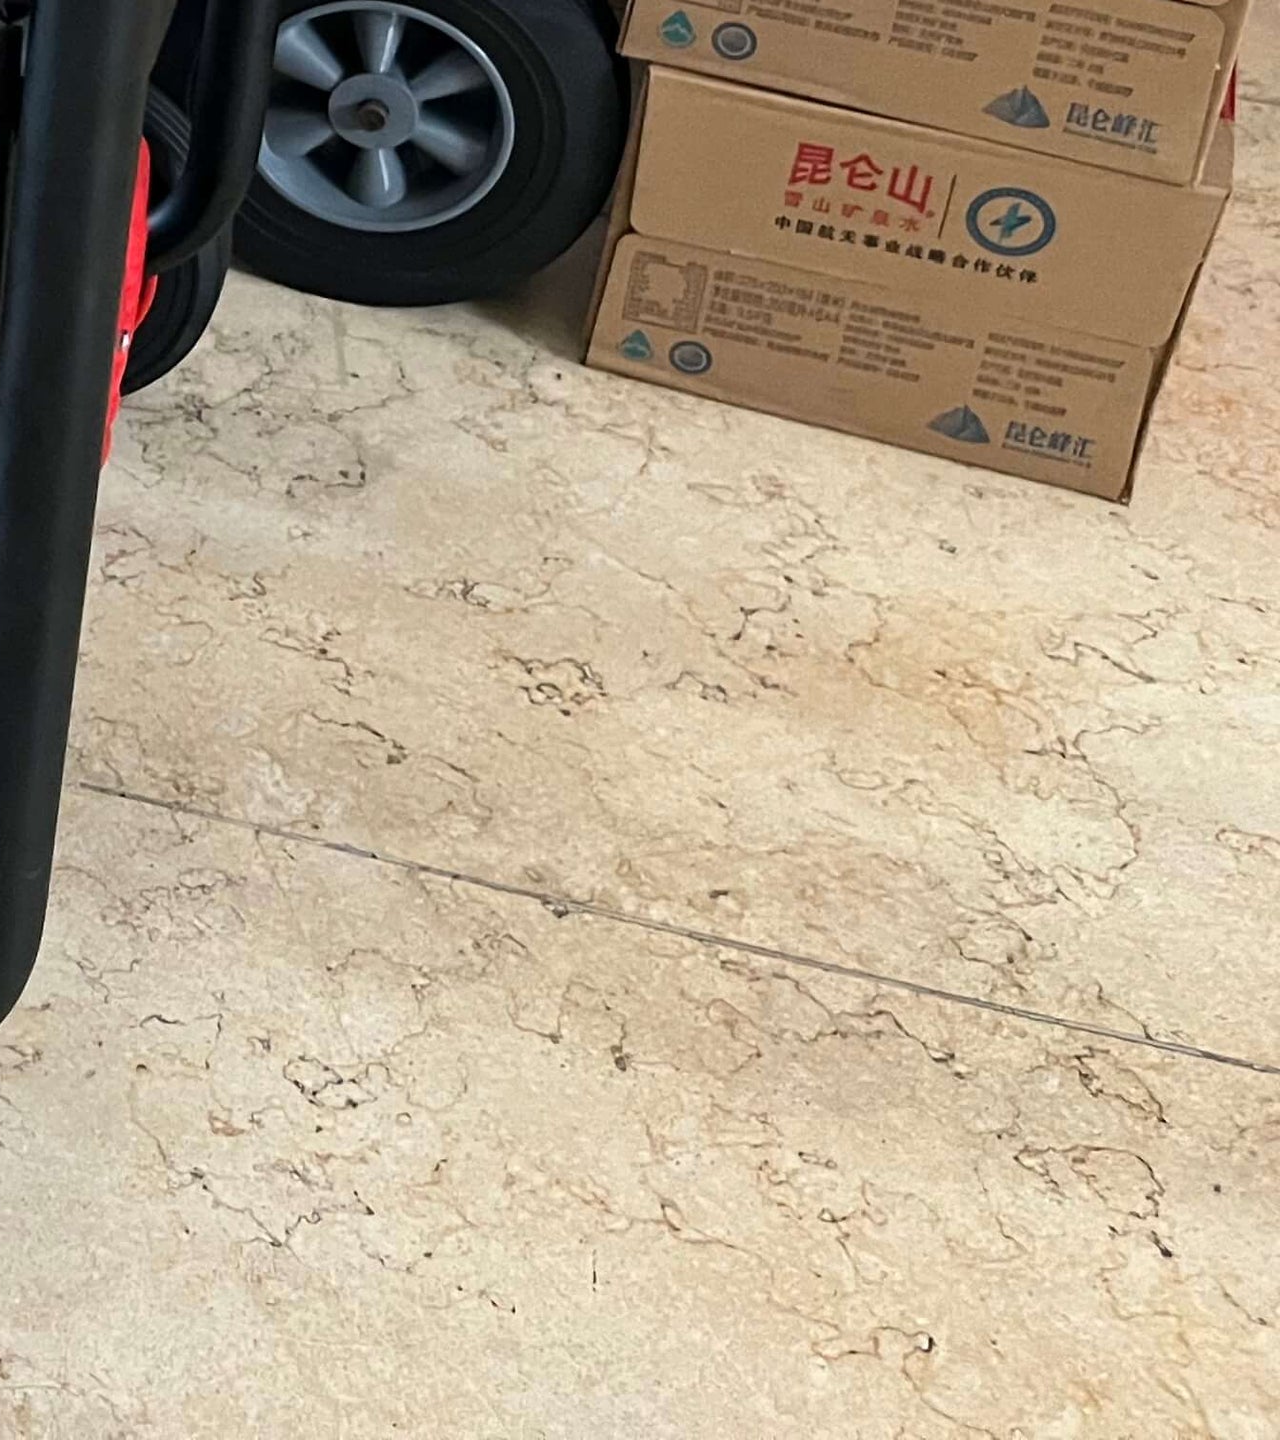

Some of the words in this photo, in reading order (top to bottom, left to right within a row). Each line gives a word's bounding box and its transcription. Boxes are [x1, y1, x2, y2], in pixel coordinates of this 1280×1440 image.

[784, 189, 921, 233] 雪山矿泉水
[788, 141, 933, 215] 昆仑山
[774, 215, 1039, 284] 中国航天事业战略合作伙伴
